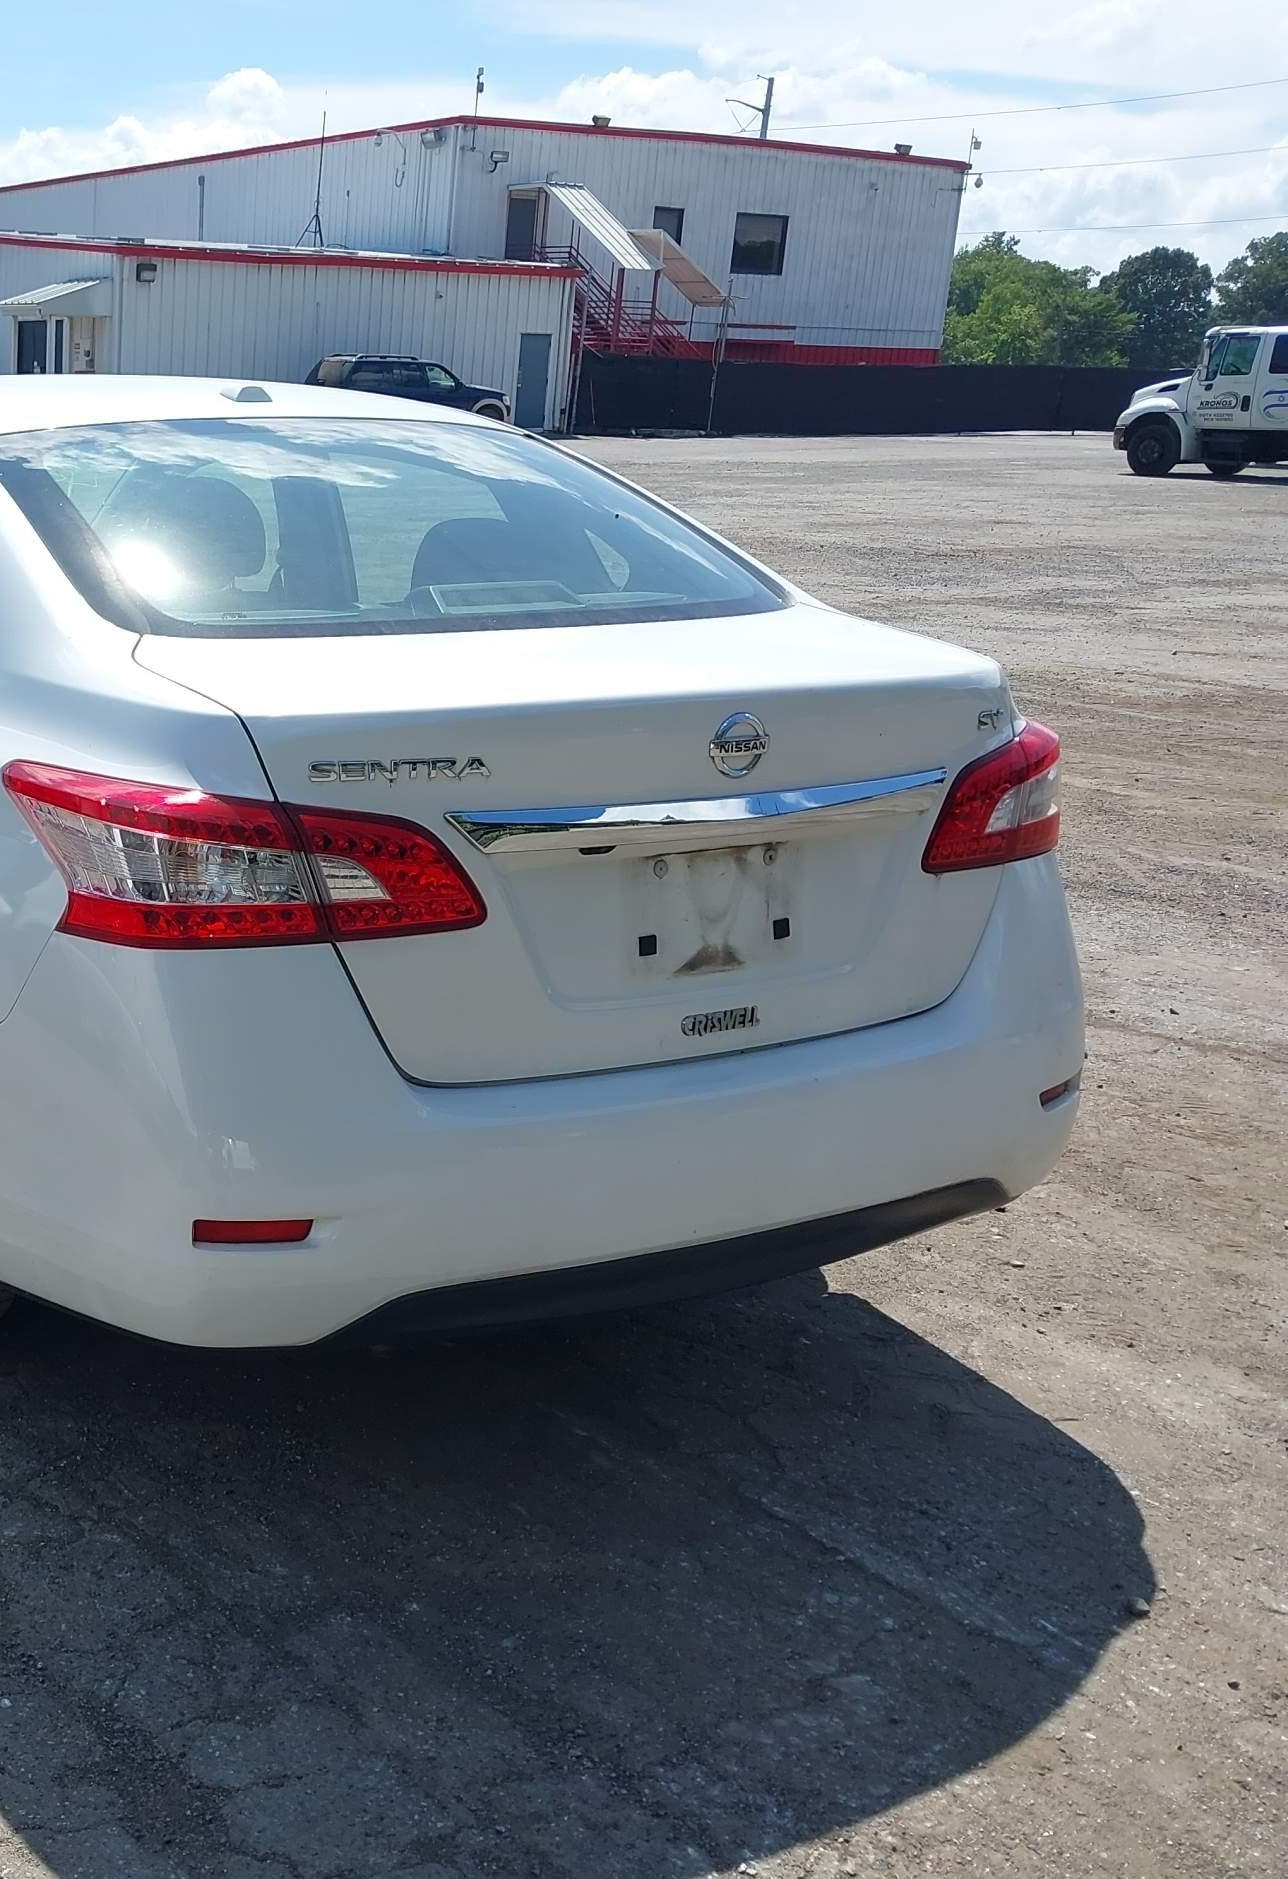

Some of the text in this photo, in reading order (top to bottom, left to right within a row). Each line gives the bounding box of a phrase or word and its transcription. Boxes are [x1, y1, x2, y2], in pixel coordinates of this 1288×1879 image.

[719, 741, 766, 753] NISSAN
[307, 756, 492, 783] SENTRA
[680, 1005, 760, 1037] CRISWELL
